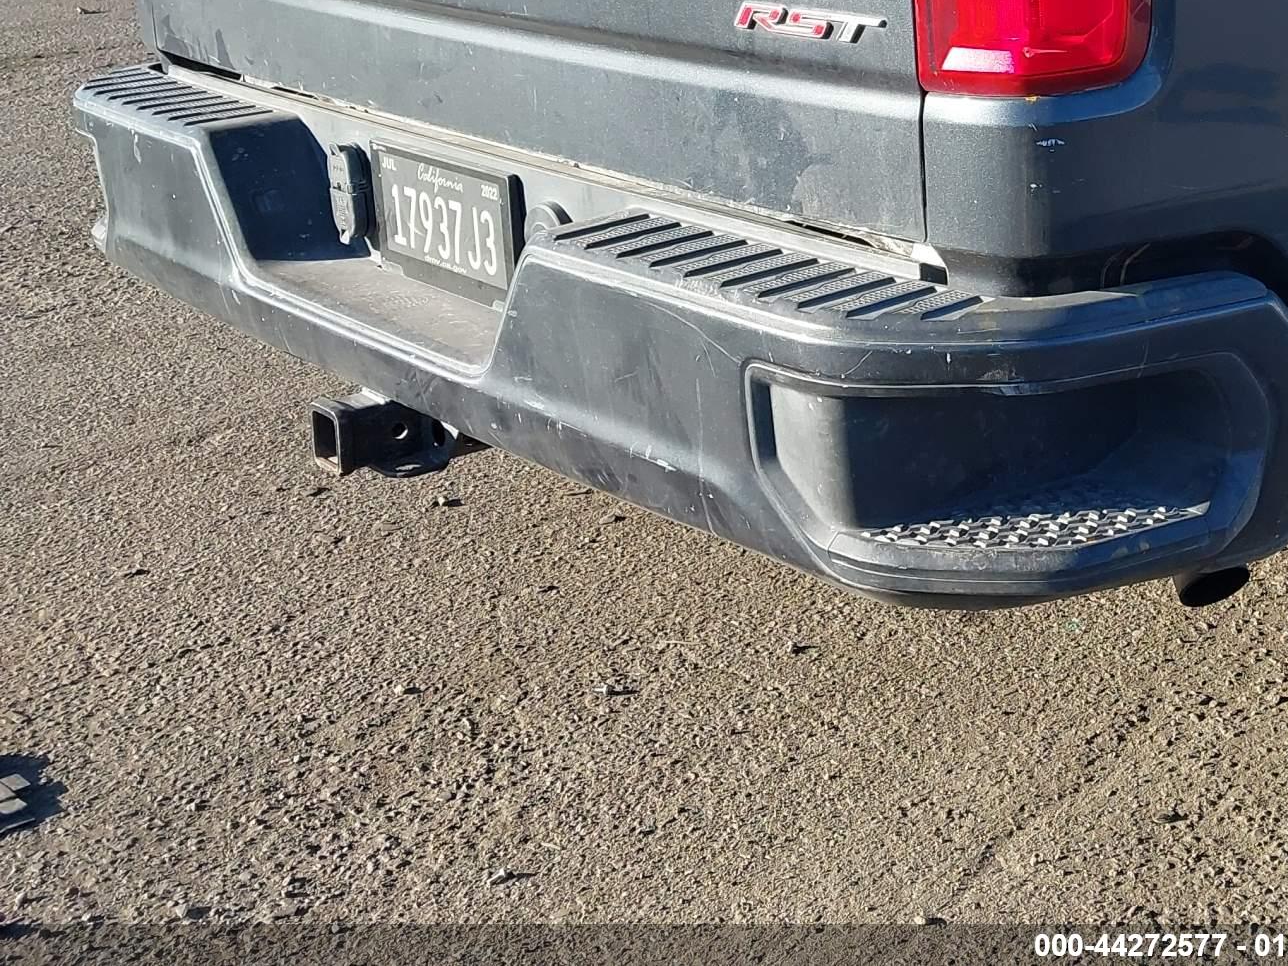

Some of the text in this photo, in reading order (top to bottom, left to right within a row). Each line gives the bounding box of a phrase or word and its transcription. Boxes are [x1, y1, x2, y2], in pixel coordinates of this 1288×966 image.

[733, 0, 889, 44] RST
[381, 156, 397, 171] JUL
[417, 162, 464, 194] California
[480, 184, 498, 201] 2022
